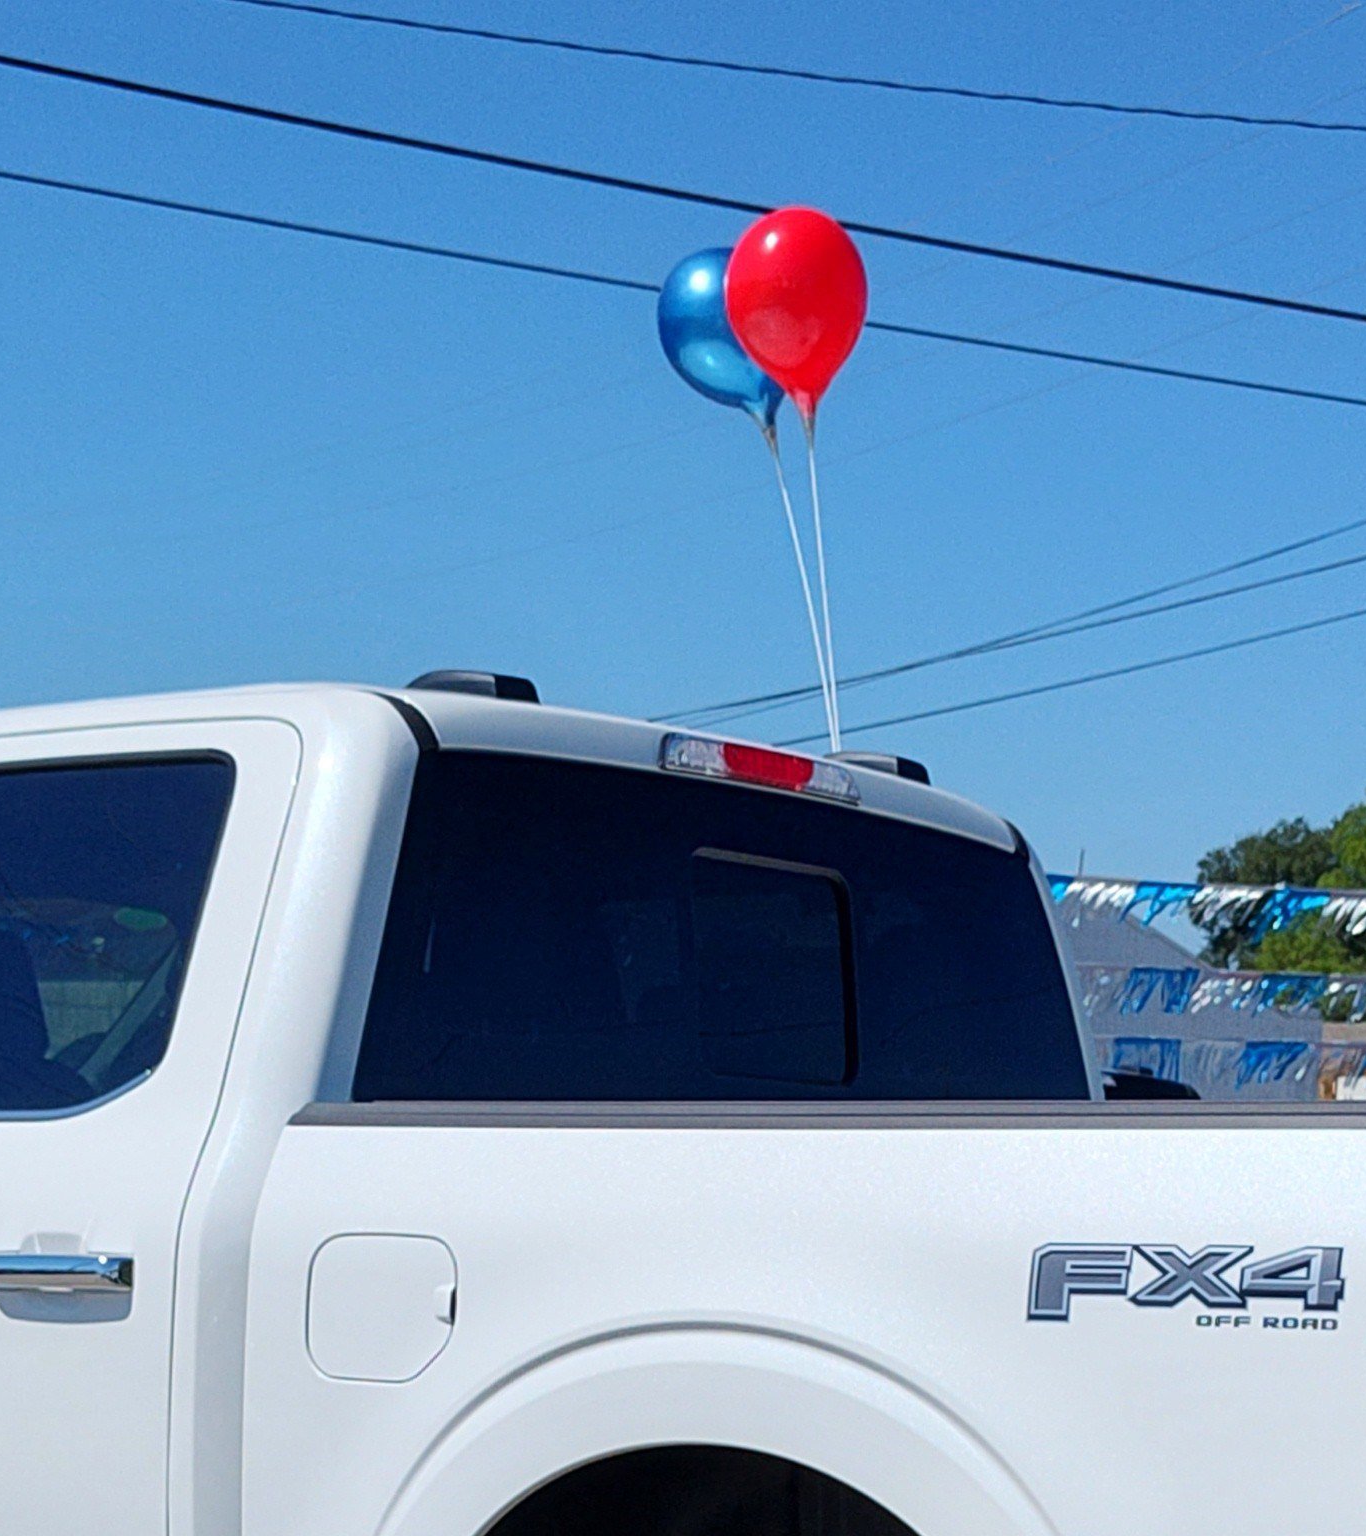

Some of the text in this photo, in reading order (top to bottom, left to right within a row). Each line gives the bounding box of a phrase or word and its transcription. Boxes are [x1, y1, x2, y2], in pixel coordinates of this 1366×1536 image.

[1026, 1242, 1346, 1322] FX4
[1195, 1314, 1339, 1331] OFF ROAD
